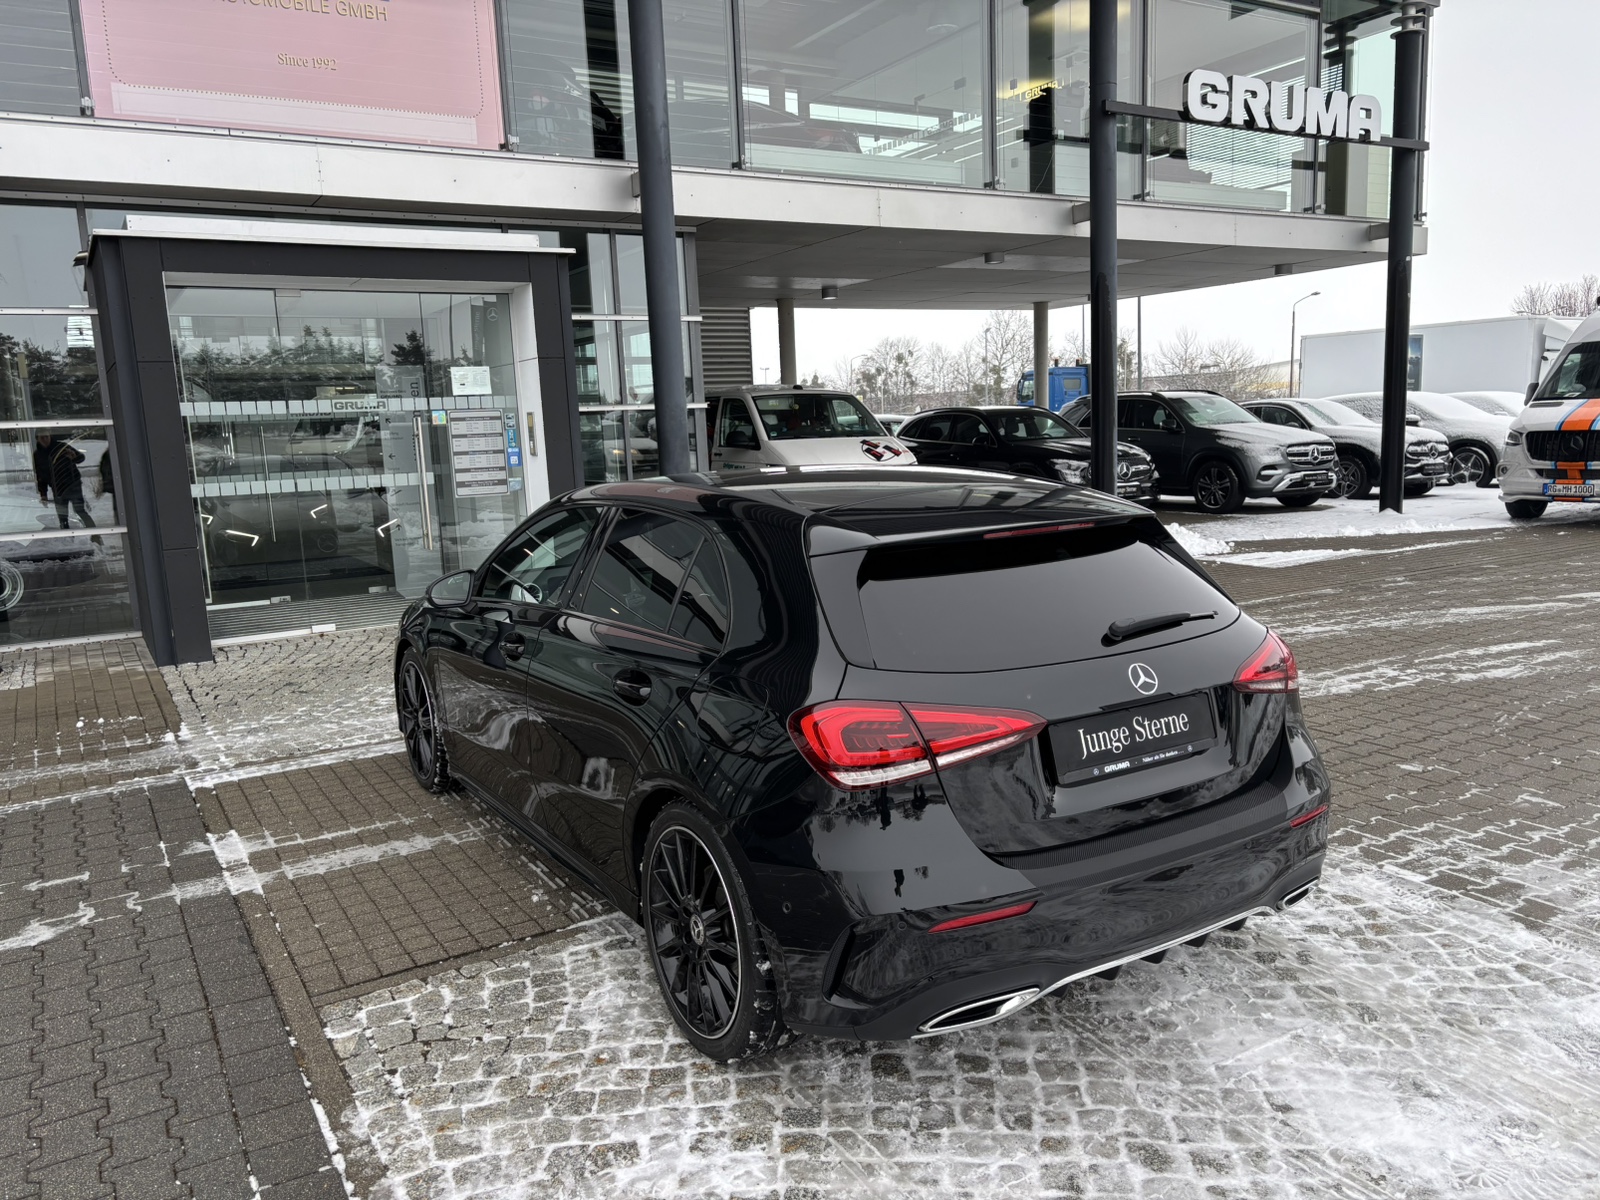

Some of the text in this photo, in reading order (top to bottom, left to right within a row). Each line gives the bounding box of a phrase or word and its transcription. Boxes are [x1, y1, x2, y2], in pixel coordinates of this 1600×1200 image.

[215, 0, 388, 21] OBILE GMBH
[277, 53, 337, 71] Since 1992
[1184, 68, 1382, 142] GRUMA
[334, 400, 387, 411] GRUA
[1573, 485, 1593, 494] 1000
[1078, 712, 1190, 760] Junge Sterne
[1104, 761, 1130, 773] GRUMA
